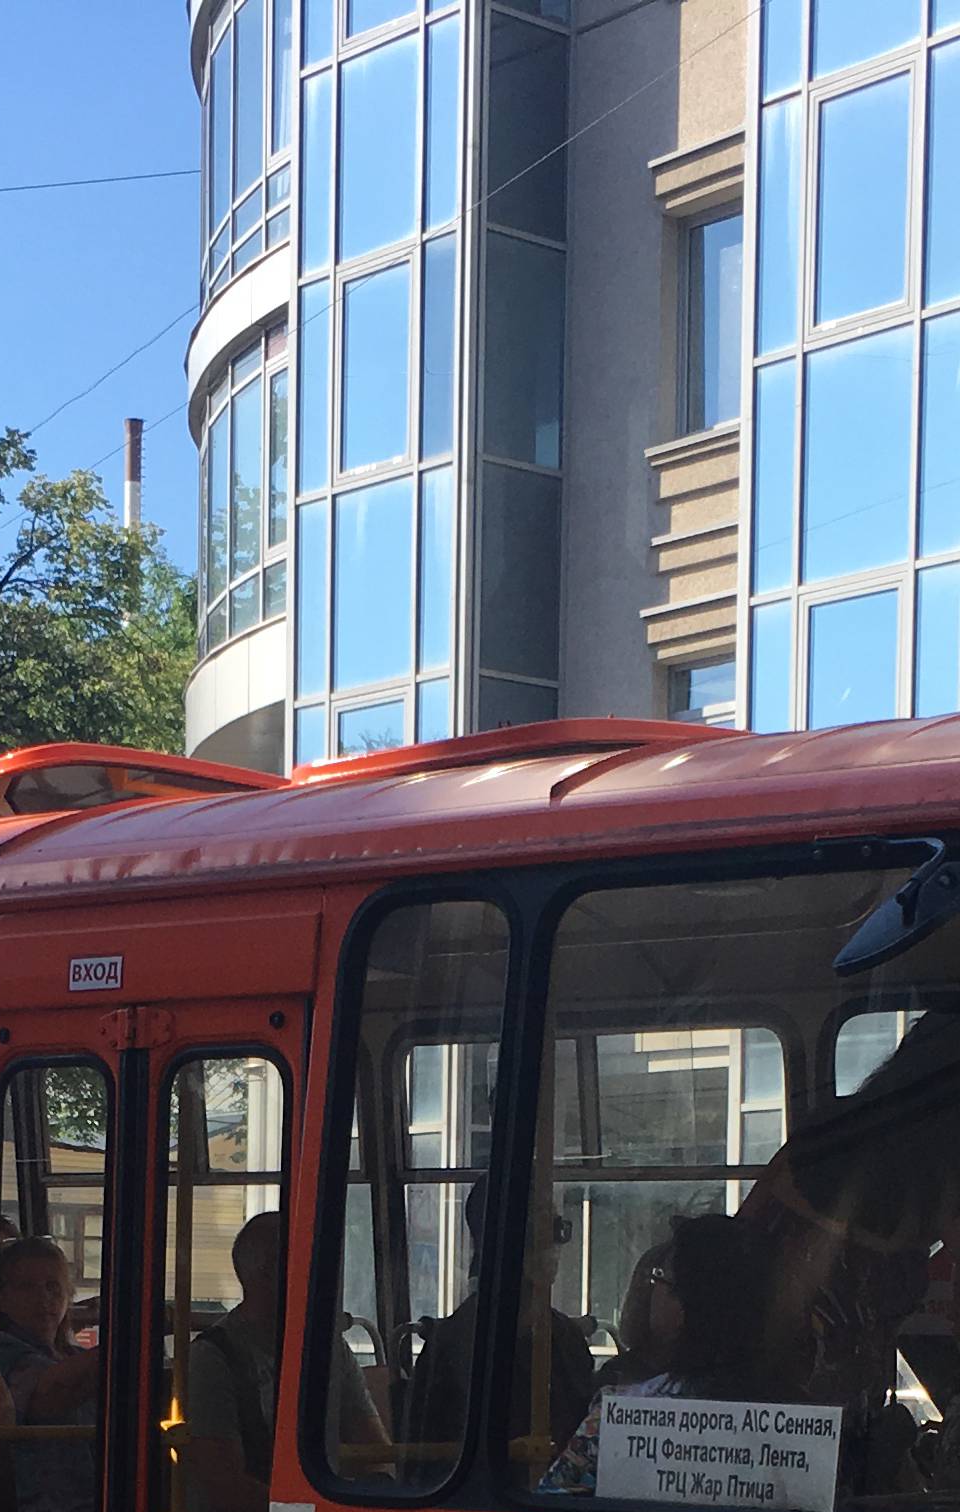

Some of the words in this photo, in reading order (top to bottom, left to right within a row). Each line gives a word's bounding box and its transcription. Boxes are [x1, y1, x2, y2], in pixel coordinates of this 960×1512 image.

[72, 962, 118, 984] ВХОД
[607, 1402, 676, 1427] Канатная
[679, 1411, 737, 1435] дорога,
[774, 1411, 837, 1440] Сенная,
[627, 1436, 657, 1464] ТРЦ
[661, 1438, 755, 1469] Фантастика,
[759, 1443, 810, 1473] Лента,
[657, 1469, 687, 1498] ТРЦ
[690, 1472, 723, 1501] Жар
[727, 1474, 775, 1503] Птица
